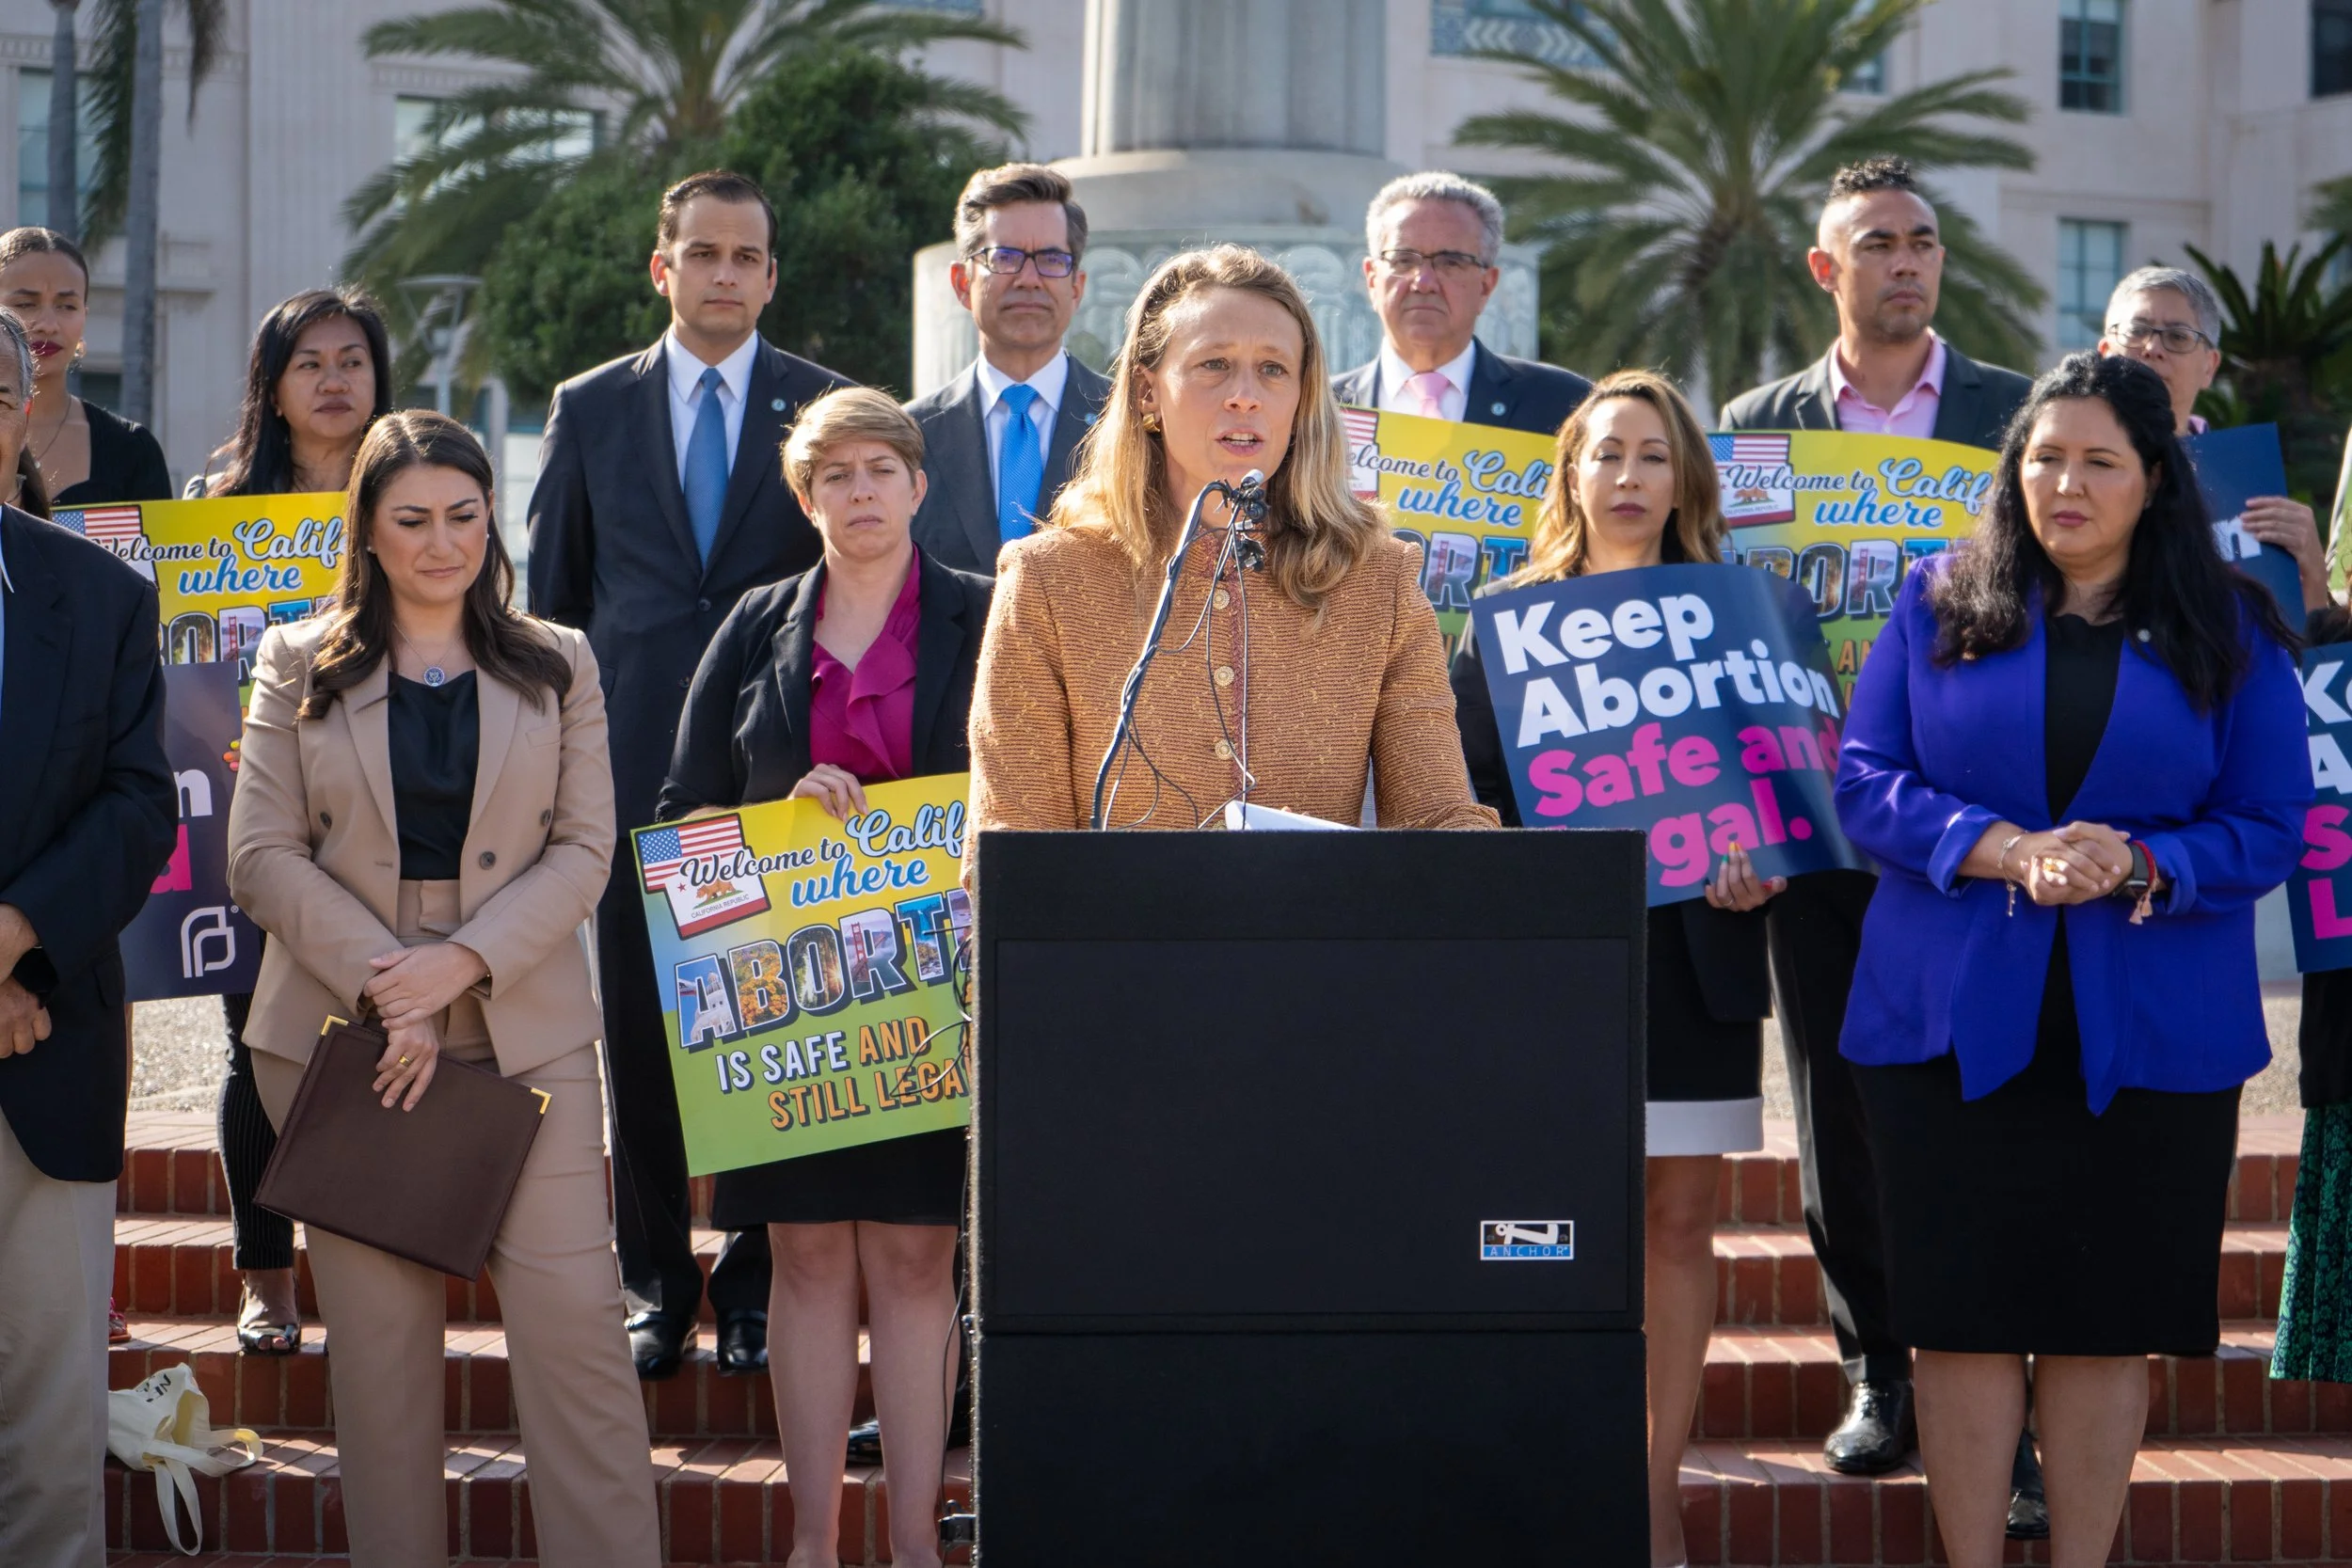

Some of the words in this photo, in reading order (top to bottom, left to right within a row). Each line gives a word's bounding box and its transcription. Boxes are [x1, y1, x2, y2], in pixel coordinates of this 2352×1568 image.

[1347, 444, 1430, 478] elcome
[1434, 460, 1459, 483] to
[1725, 465, 1845, 492] Welcome
[1850, 470, 1875, 491] to
[1399, 481, 1521, 528] where
[1815, 488, 1943, 528] where
[179, 554, 302, 594] where
[209, 537, 231, 558] to
[1494, 593, 1714, 675] Keep
[1516, 640, 1840, 749] Abortion
[1528, 721, 1721, 816] Safe
[679, 847, 815, 887] Welcome
[819, 837, 846, 864] to
[846, 799, 967, 859] Calif
[1650, 778, 1812, 887] gal.
[691, 903, 723, 918] CALIFORNIA
[723, 894, 750, 908] REPUBLIC
[790, 853, 930, 909] where
[715, 1051, 752, 1092] IS
[760, 1031, 849, 1082] SAFE
[859, 1016, 930, 1065] AND
[769, 1073, 867, 1129] STILL
